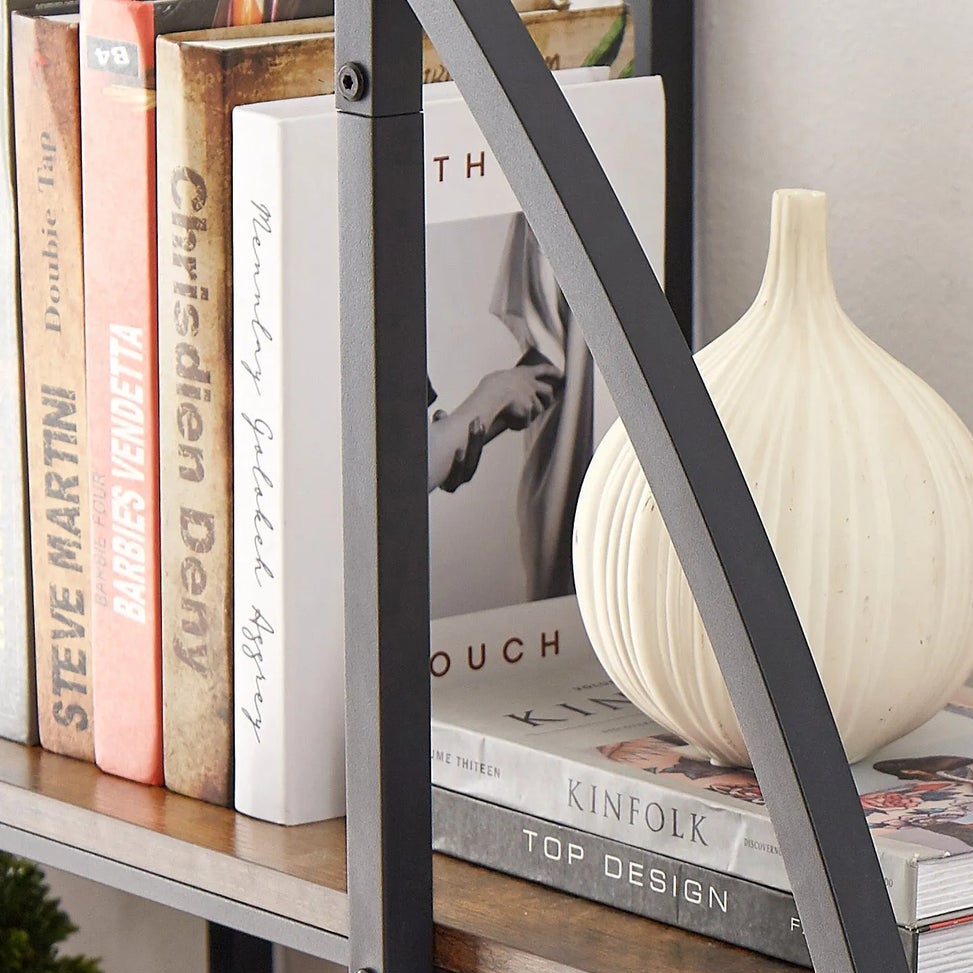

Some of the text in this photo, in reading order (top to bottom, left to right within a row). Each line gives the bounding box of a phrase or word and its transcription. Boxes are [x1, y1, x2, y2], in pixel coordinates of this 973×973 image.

[37, 131, 57, 193] Tap
[108, 323, 145, 483] VENDETTA
[170, 165, 215, 679] Chrisdien Deny
[41, 384, 89, 732] STEVE MARTINI
[523, 829, 728, 913] TOP DESIGN
[568, 778, 709, 846] KINFOLK
